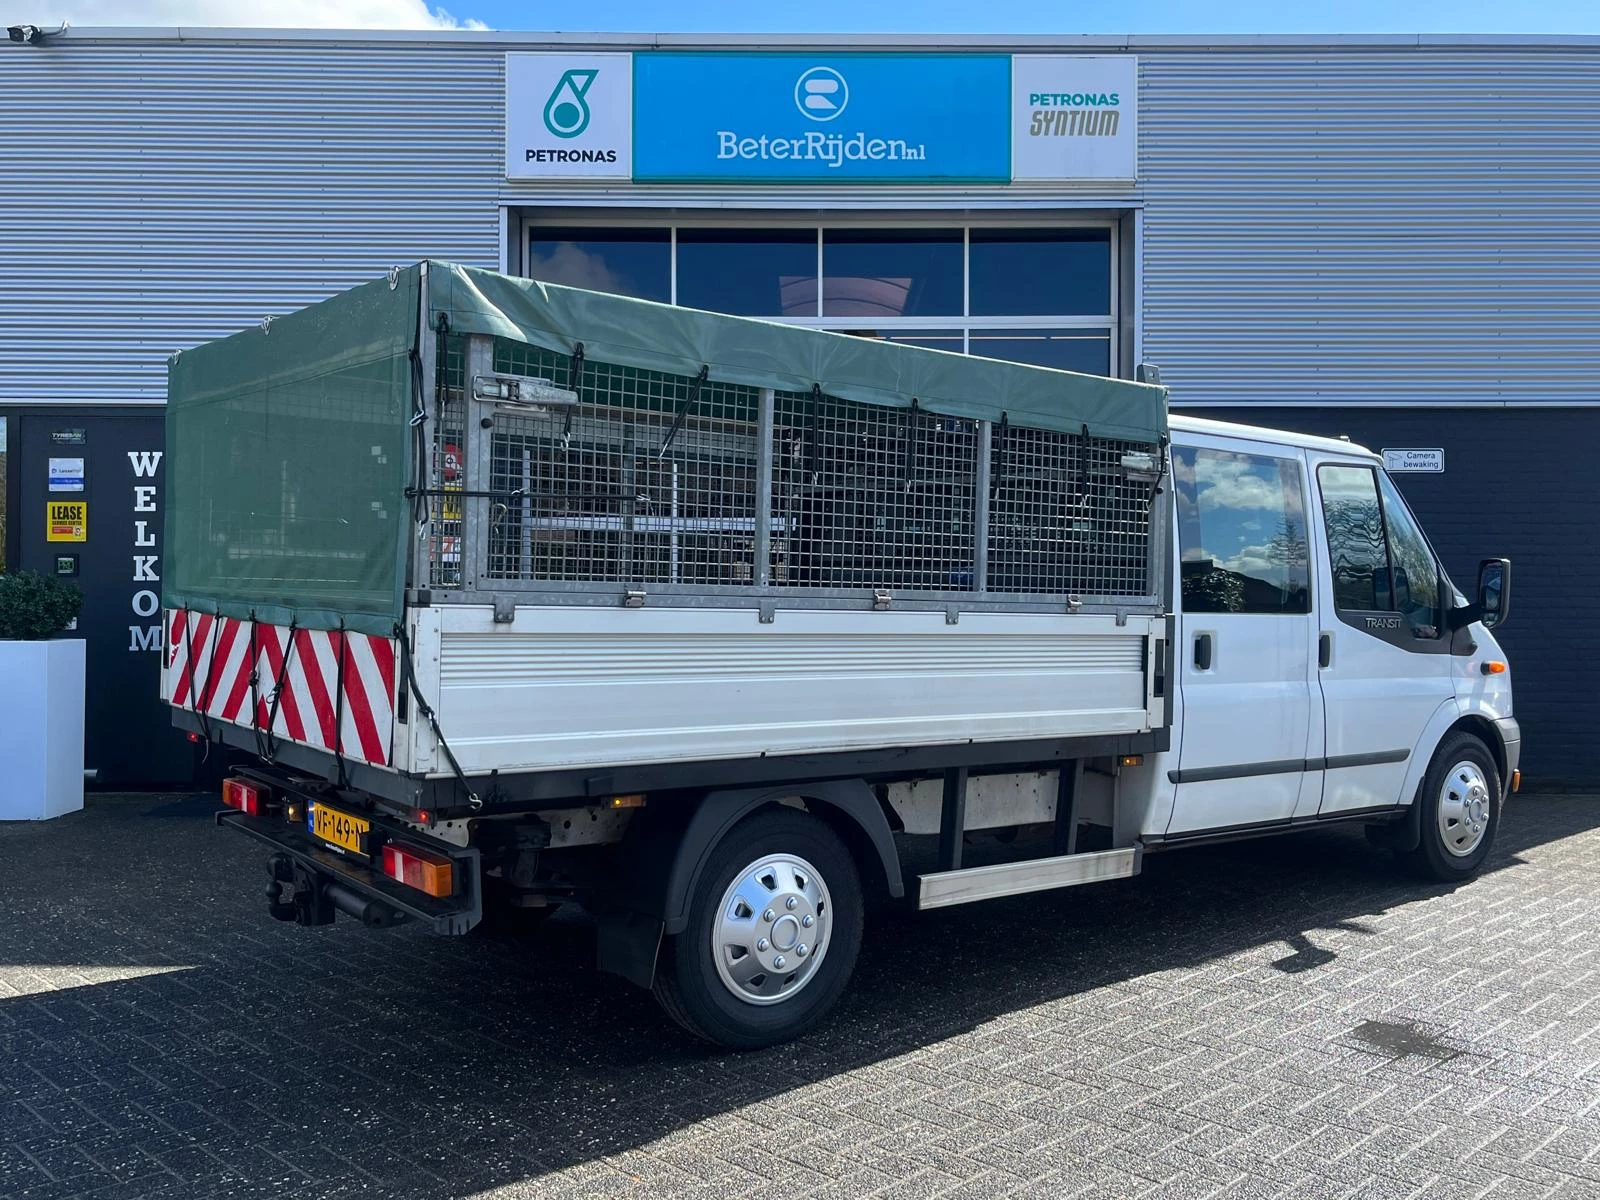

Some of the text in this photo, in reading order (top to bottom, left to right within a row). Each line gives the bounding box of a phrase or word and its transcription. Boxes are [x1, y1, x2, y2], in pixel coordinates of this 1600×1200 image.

[1029, 93, 1120, 106] PETRONAS
[1030, 110, 1120, 137] SYNTIUM
[525, 149, 617, 163] PETRONAS
[1406, 451, 1436, 459] Camera
[1403, 460, 1439, 469] bewaking
[52, 505, 82, 520] LEASE
[127, 451, 163, 651] WELKOM
[1365, 617, 1401, 628] TRANSIT
